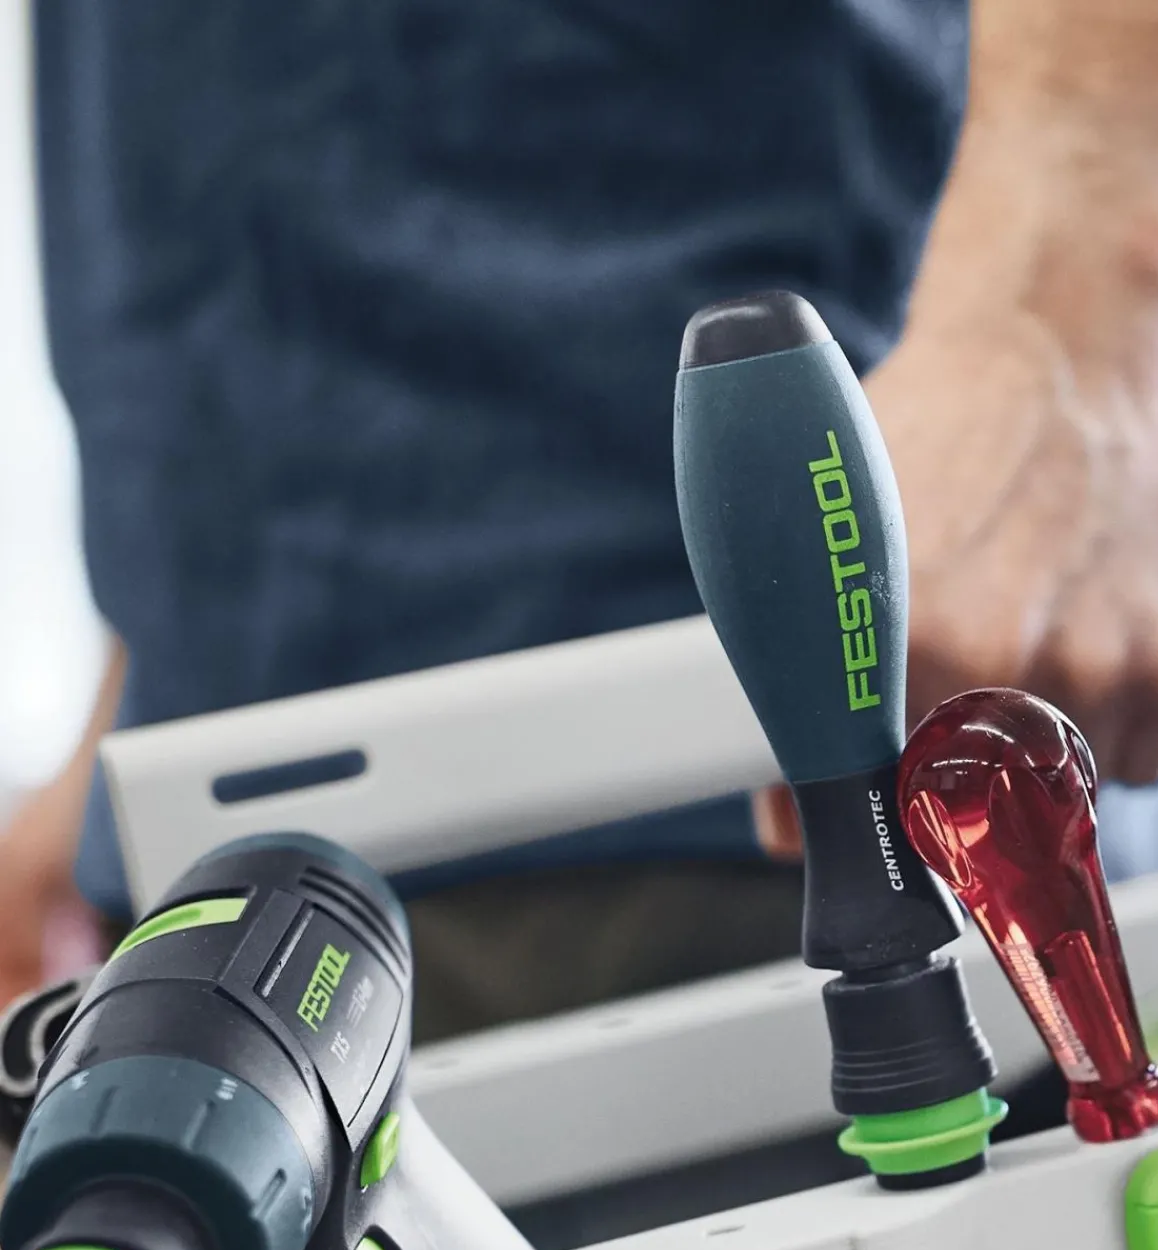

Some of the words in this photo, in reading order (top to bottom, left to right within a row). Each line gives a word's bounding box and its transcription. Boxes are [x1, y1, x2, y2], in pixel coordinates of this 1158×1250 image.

[808, 430, 881, 711] FESTOOL
[869, 790, 904, 891] CENTROTEC
[297, 943, 351, 1032] FESTOOL
